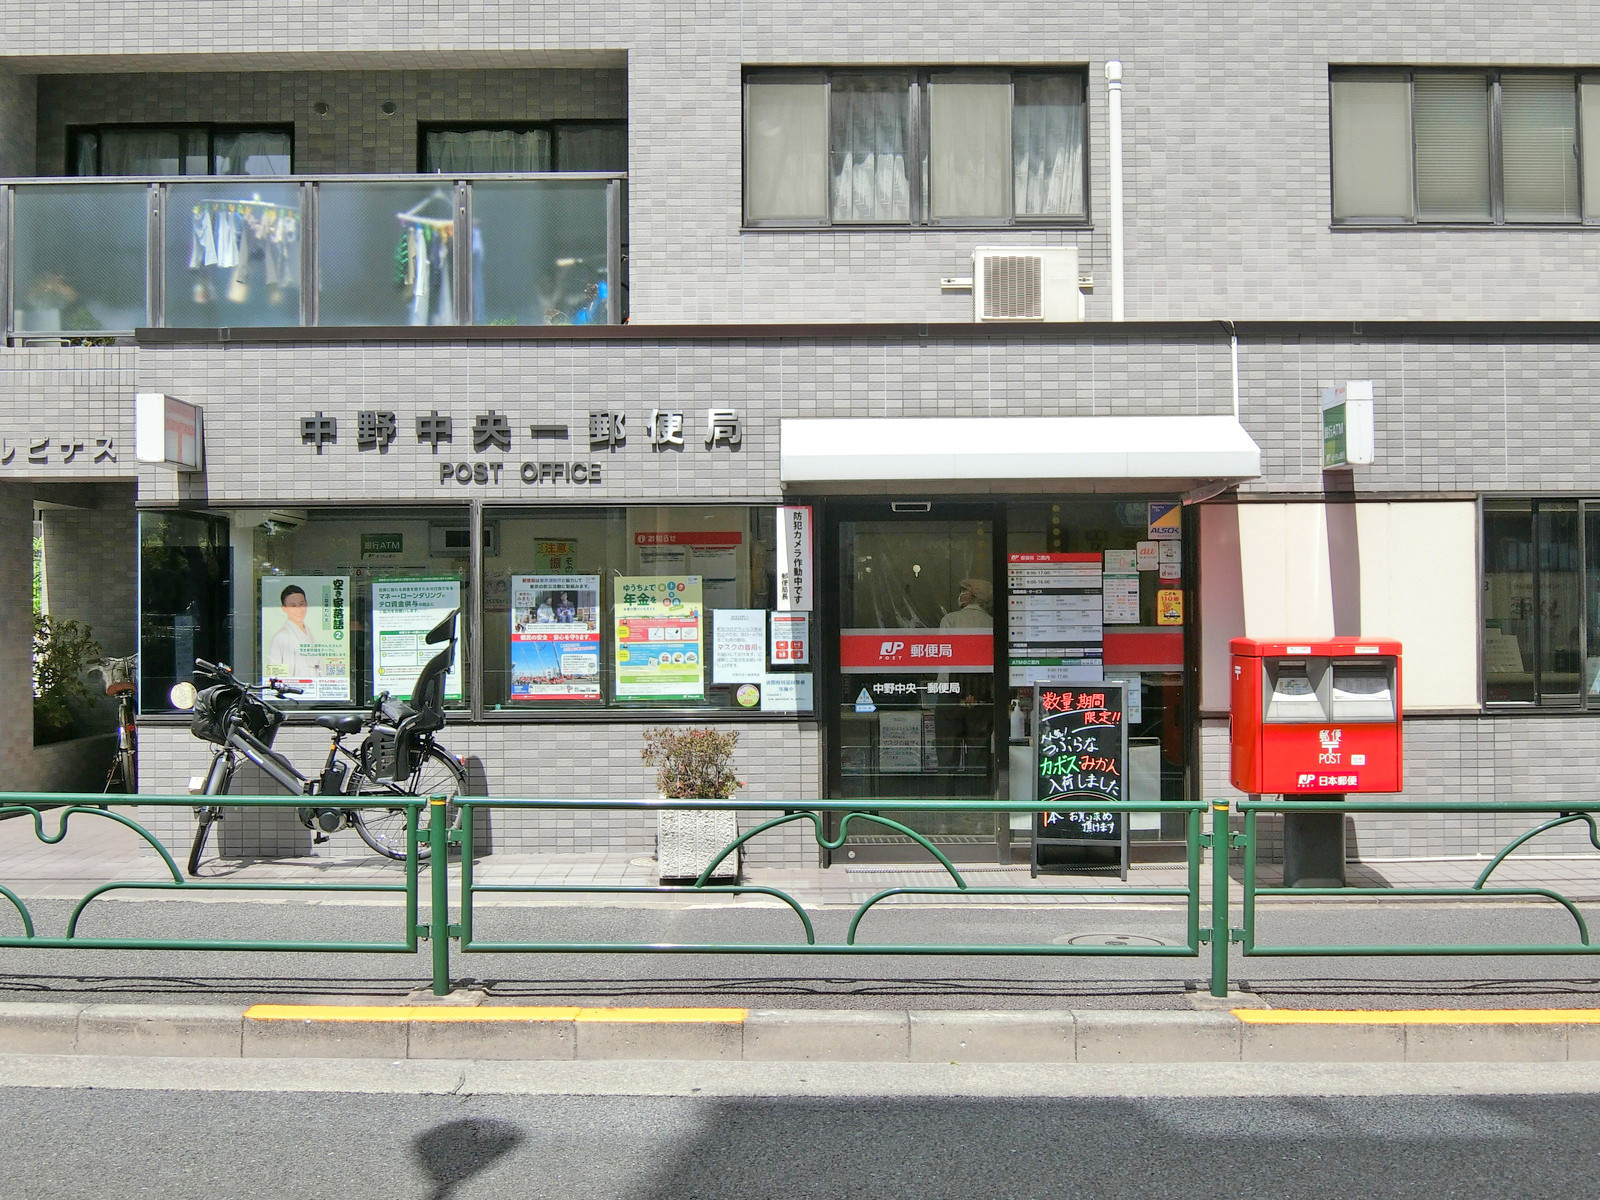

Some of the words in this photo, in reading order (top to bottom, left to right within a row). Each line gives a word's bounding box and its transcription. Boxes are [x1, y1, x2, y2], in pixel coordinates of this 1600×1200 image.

[300, 408, 742, 454] 中野中央一郵便局
[440, 461, 503, 484] POST
[520, 461, 602, 484] OFFICE
[794, 512, 802, 604] 防犯カメラ作動中です
[623, 584, 656, 592] ゆうちょで
[333, 579, 344, 630] 空き家落語
[623, 593, 656, 606] 年金を
[910, 644, 952, 658] 郵便局
[873, 682, 960, 694] 中野中央一郵便局
[1042, 692, 1074, 712] 数量
[1076, 693, 1104, 710] 期間
[1084, 710, 1120, 725] 限定!!
[1319, 729, 1342, 742] 郵便
[1043, 736, 1098, 755] つぶらな
[1040, 754, 1120, 776] カボス・みかん
[1318, 754, 1342, 764] POST
[1049, 774, 1120, 796] 入荷しました
[1318, 776, 1357, 786] 日本郵便
[1082, 822, 1114, 834] 頂けます
